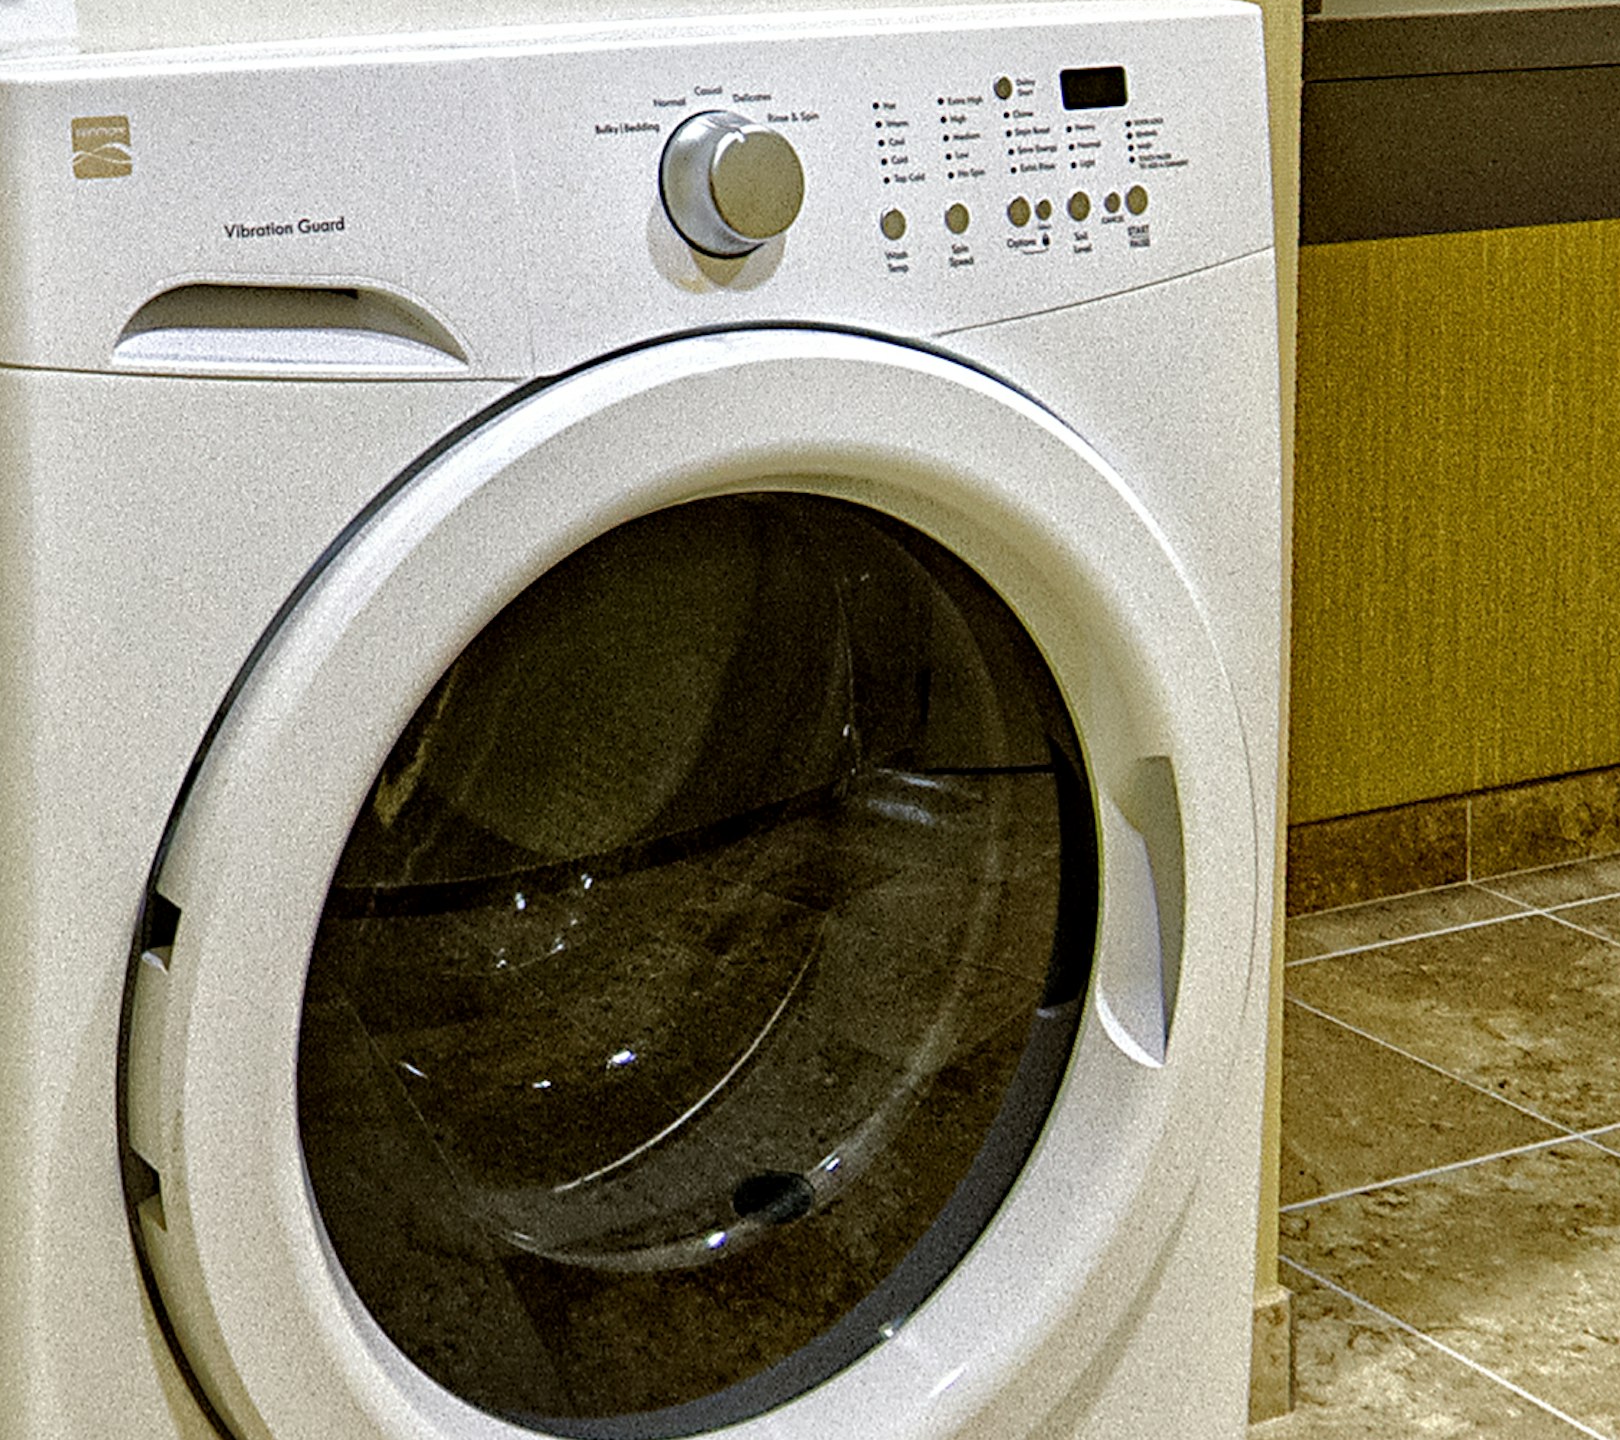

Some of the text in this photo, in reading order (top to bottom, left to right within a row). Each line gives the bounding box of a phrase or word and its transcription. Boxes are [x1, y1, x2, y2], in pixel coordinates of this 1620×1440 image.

[694, 86, 723, 96] Casual
[653, 97, 686, 107] Normal
[800, 111, 819, 122] Spin
[595, 125, 618, 135] Bulky
[624, 122, 660, 134] Bedding
[223, 216, 345, 239] Vibration Guard
